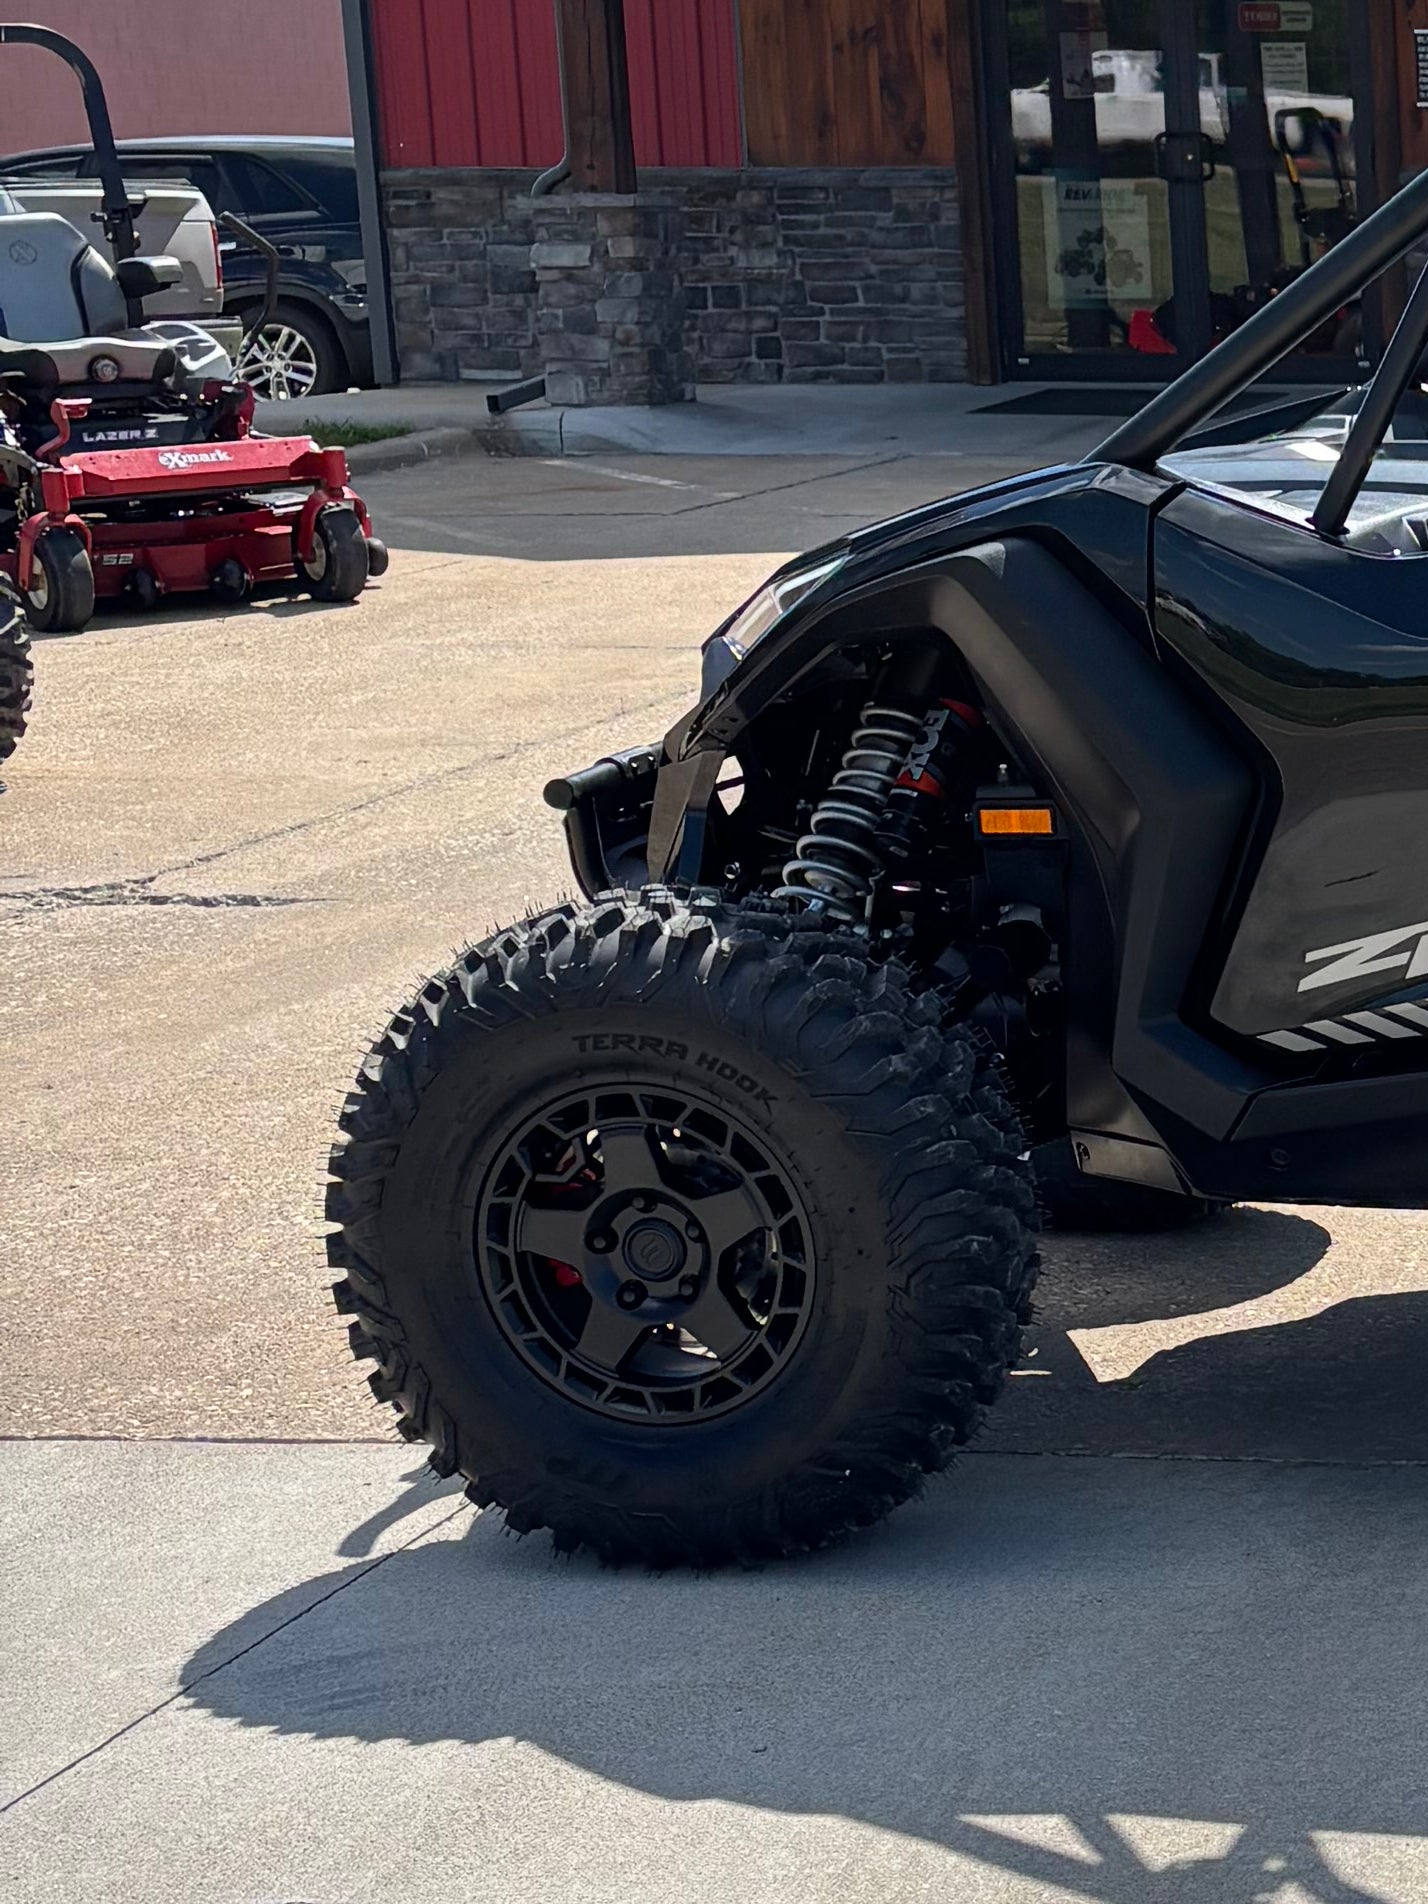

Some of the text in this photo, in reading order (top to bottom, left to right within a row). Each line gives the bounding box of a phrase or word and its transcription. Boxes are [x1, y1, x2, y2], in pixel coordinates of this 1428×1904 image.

[82, 427, 160, 443] LAZER Z
[571, 1032, 780, 1117] TERRA HOOK
